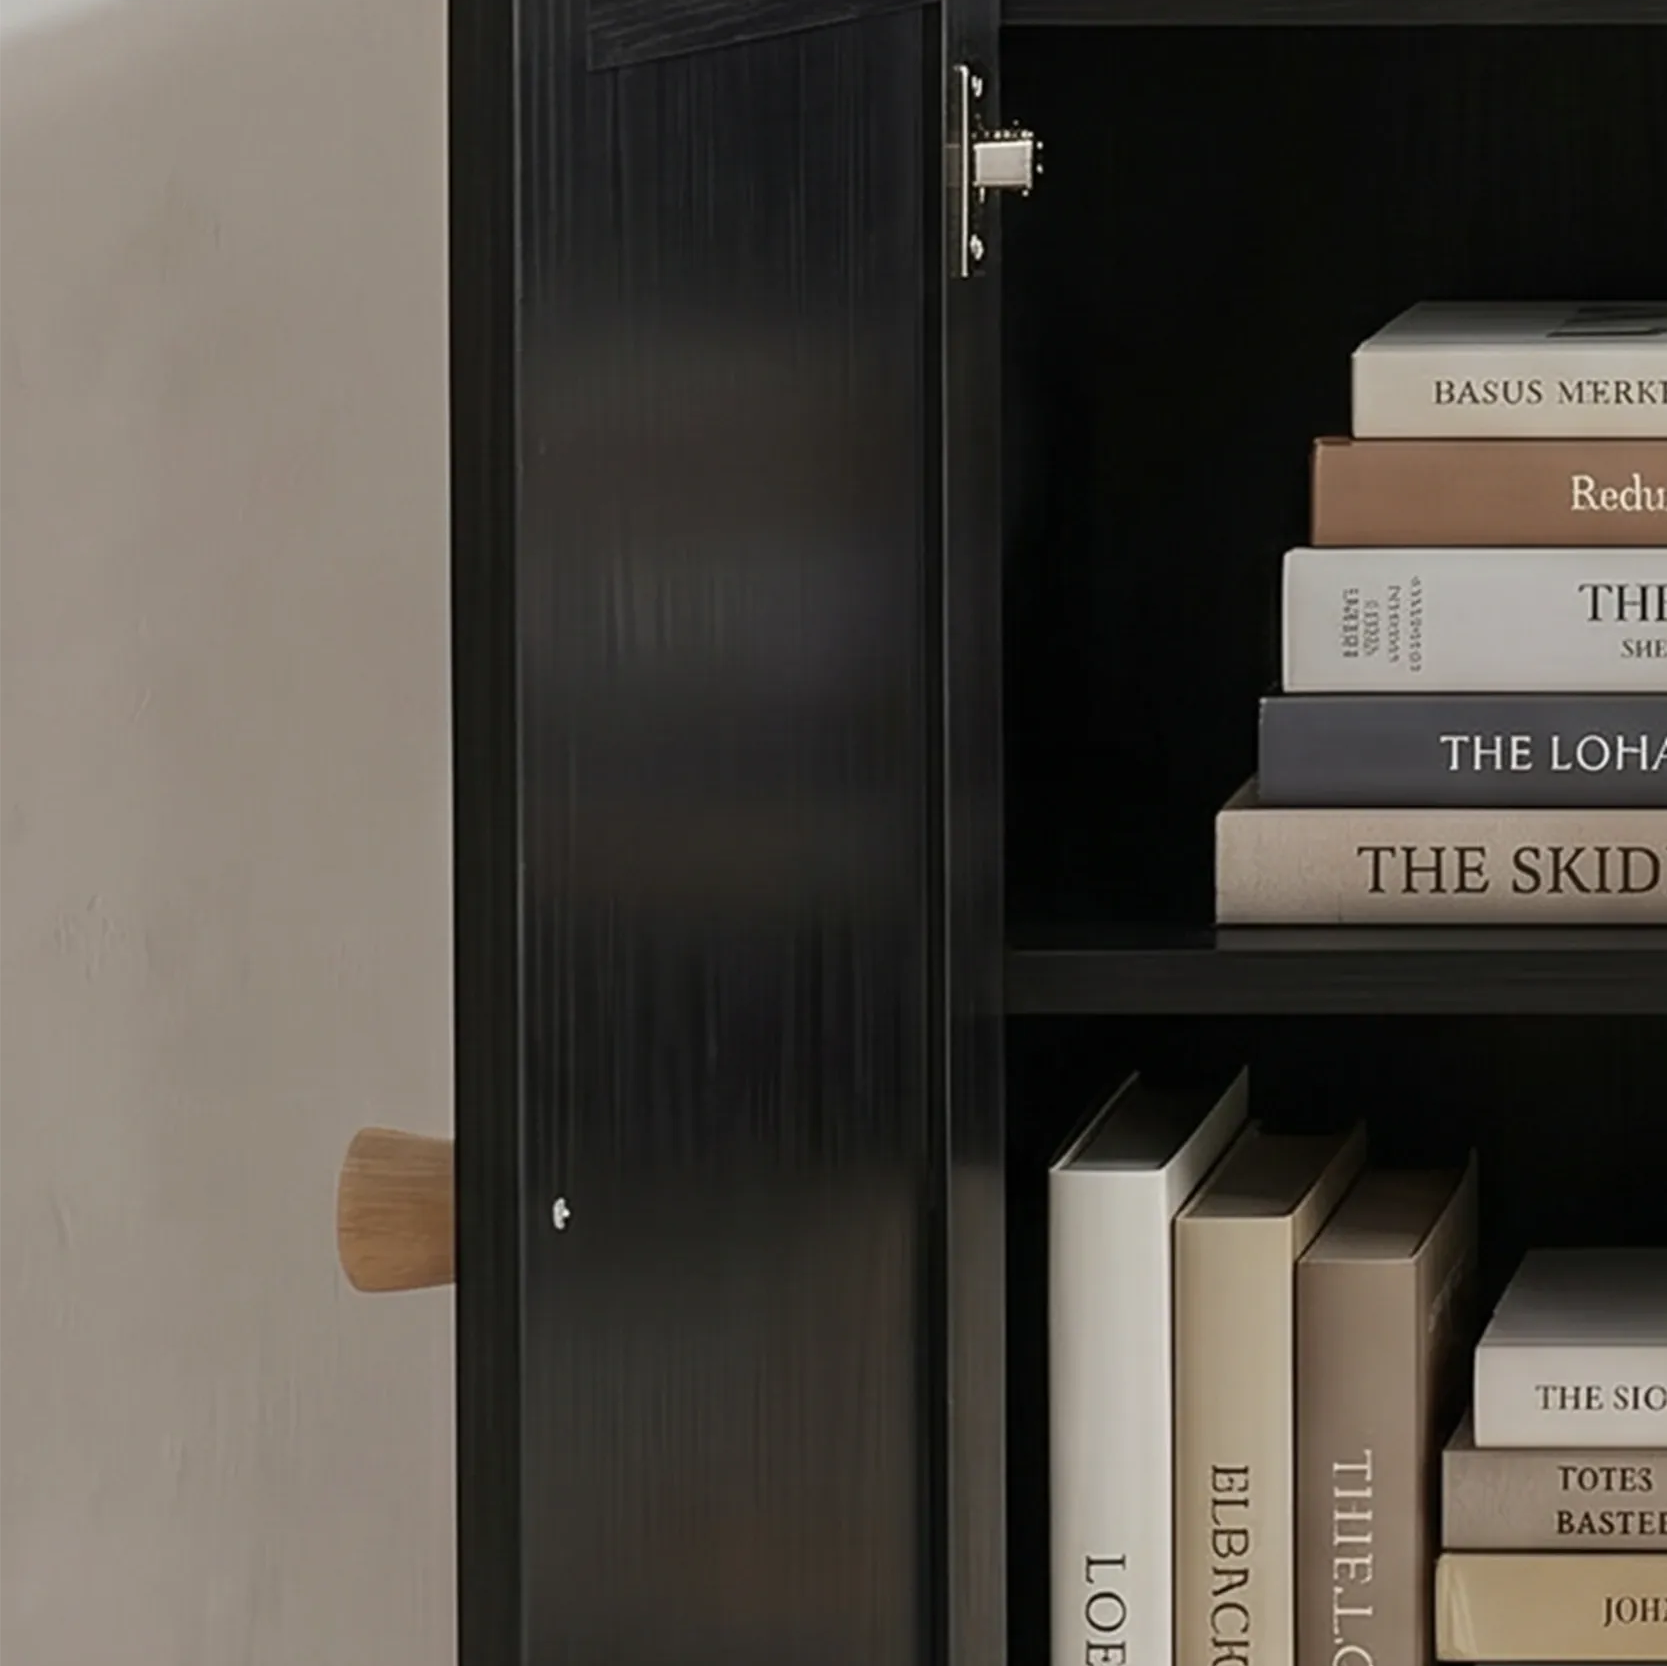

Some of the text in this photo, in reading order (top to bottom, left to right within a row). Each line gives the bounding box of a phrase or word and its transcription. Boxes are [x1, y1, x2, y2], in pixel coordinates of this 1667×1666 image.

[1433, 379, 1544, 406] BASUS
[1439, 734, 1534, 773] THE
[1356, 844, 1491, 896] THE
[1535, 1385, 1604, 1411] THE
